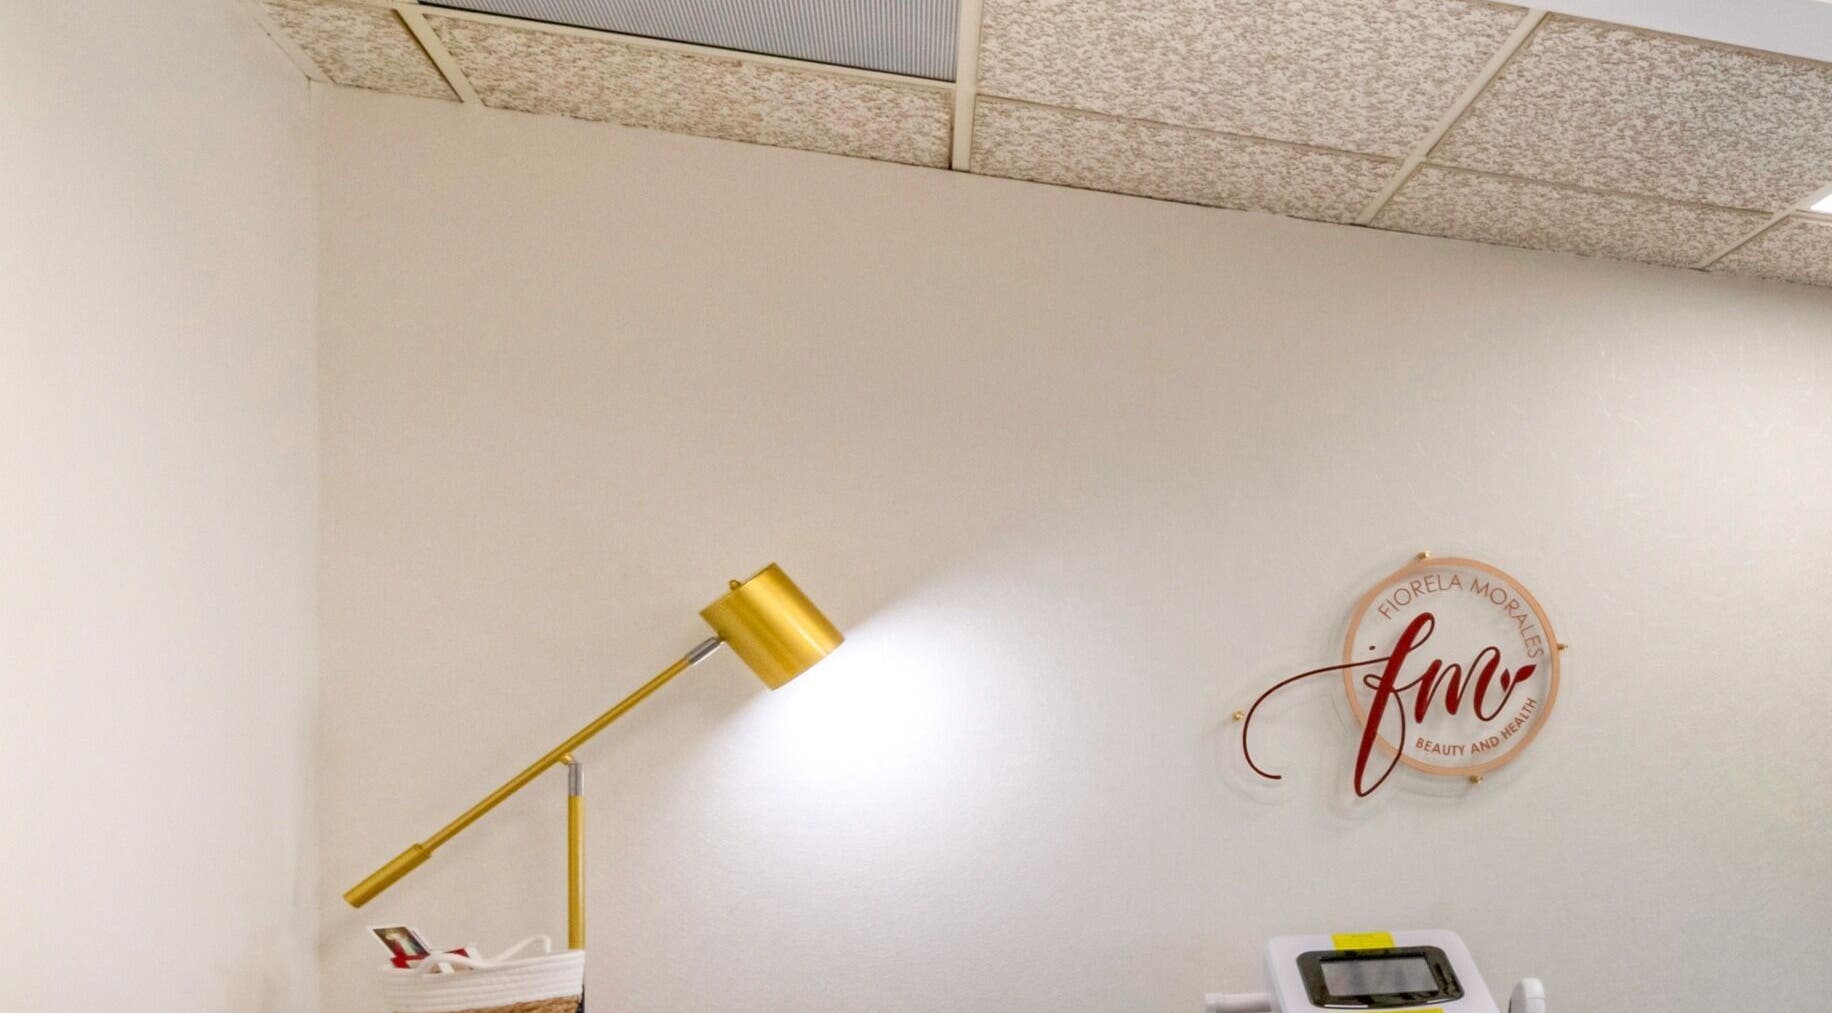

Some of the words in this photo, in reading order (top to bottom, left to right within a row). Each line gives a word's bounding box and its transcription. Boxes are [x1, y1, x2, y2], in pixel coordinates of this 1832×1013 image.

[1377, 574, 1463, 621] FIORELA
[1470, 577, 1545, 660] MORALES
[1415, 737, 1466, 757] BEAUTY
[1470, 735, 1501, 756] AND
[1499, 697, 1538, 742] HEALTH
